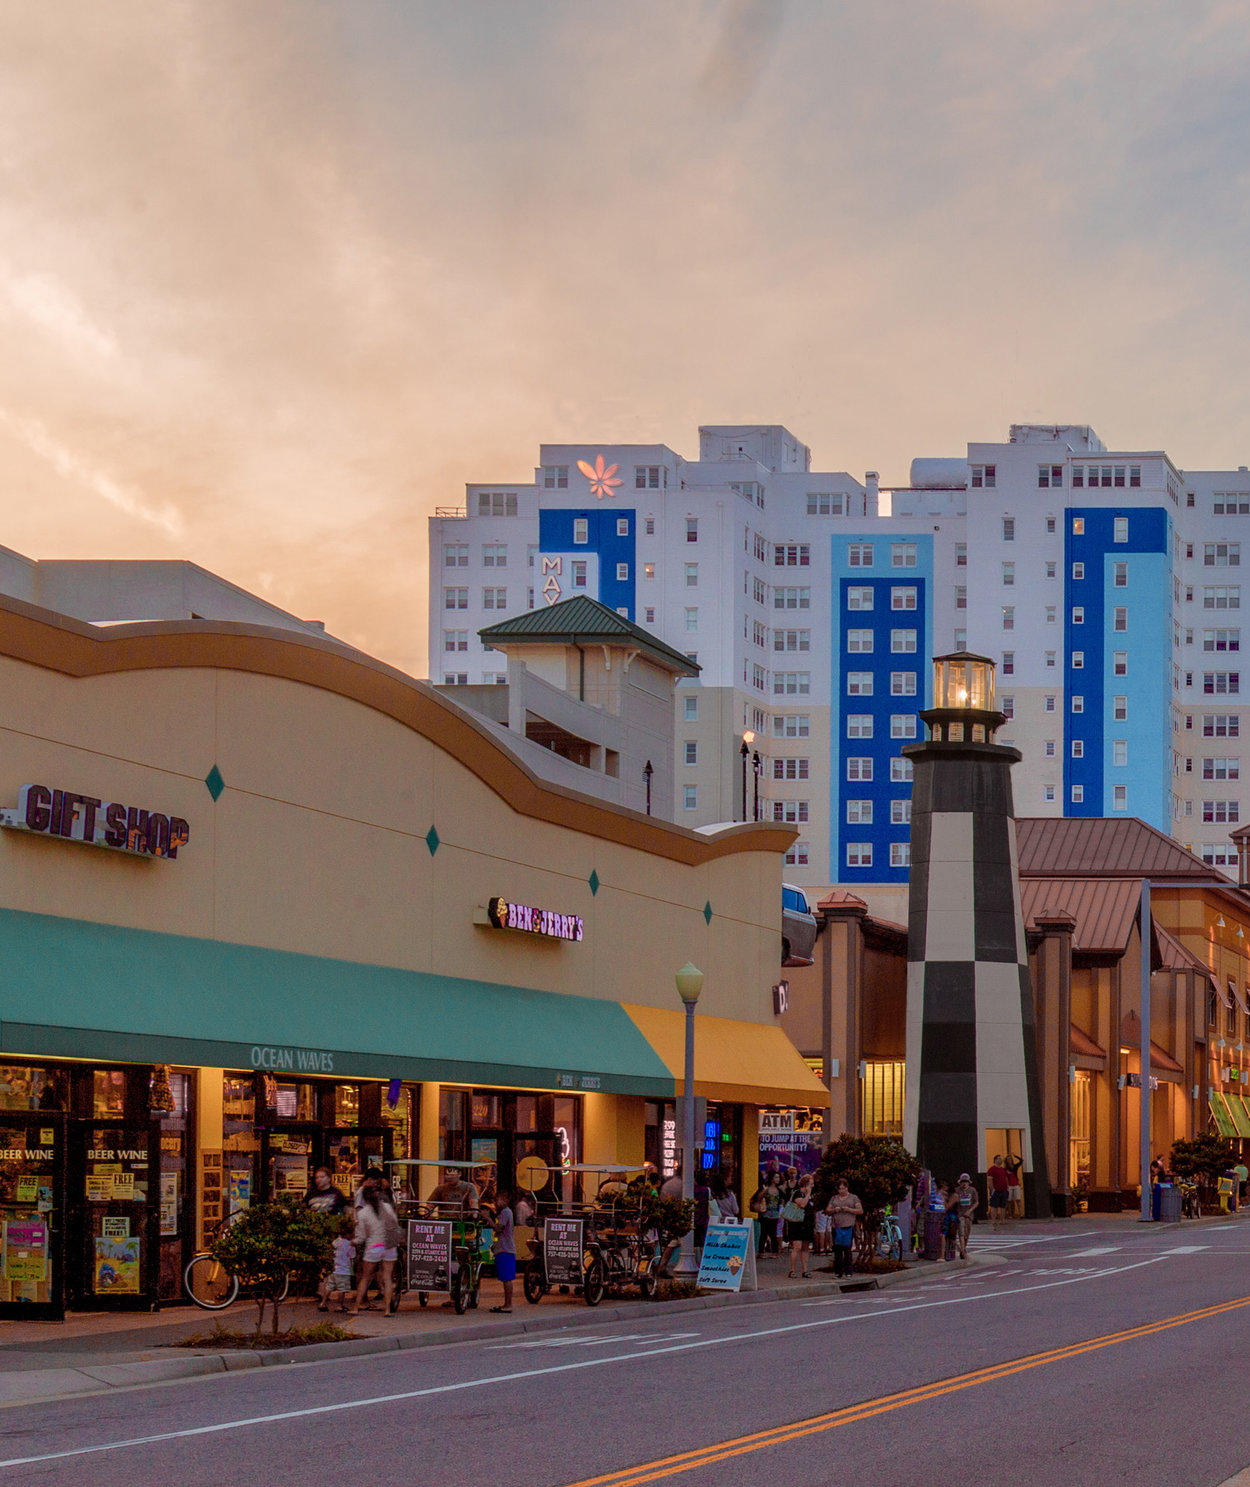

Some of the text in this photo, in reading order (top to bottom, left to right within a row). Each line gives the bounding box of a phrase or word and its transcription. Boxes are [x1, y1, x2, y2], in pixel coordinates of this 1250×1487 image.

[25, 784, 190, 859] GIFT SHOP
[508, 903, 533, 931] BEN
[541, 910, 584, 942] JERRY'S
[250, 1047, 334, 1072] OCEAN WAVES
[762, 1115, 791, 1128] ATM
[771, 1135, 789, 1143] JUMP
[798, 1135, 810, 1143] THE
[759, 1143, 808, 1151] OPPORTUNITY?
[0, 1149, 54, 1160] BEER WINE
[88, 1149, 148, 1160] BEER WINE
[20, 1177, 38, 1186] FREE
[114, 1174, 133, 1184] FREE
[333, 1175, 349, 1183] FREE
[415, 1225, 445, 1234] RENT ME
[551, 1223, 576, 1232] RENT ME
[425, 1234, 434, 1242] AT
[559, 1232, 568, 1240] AT
